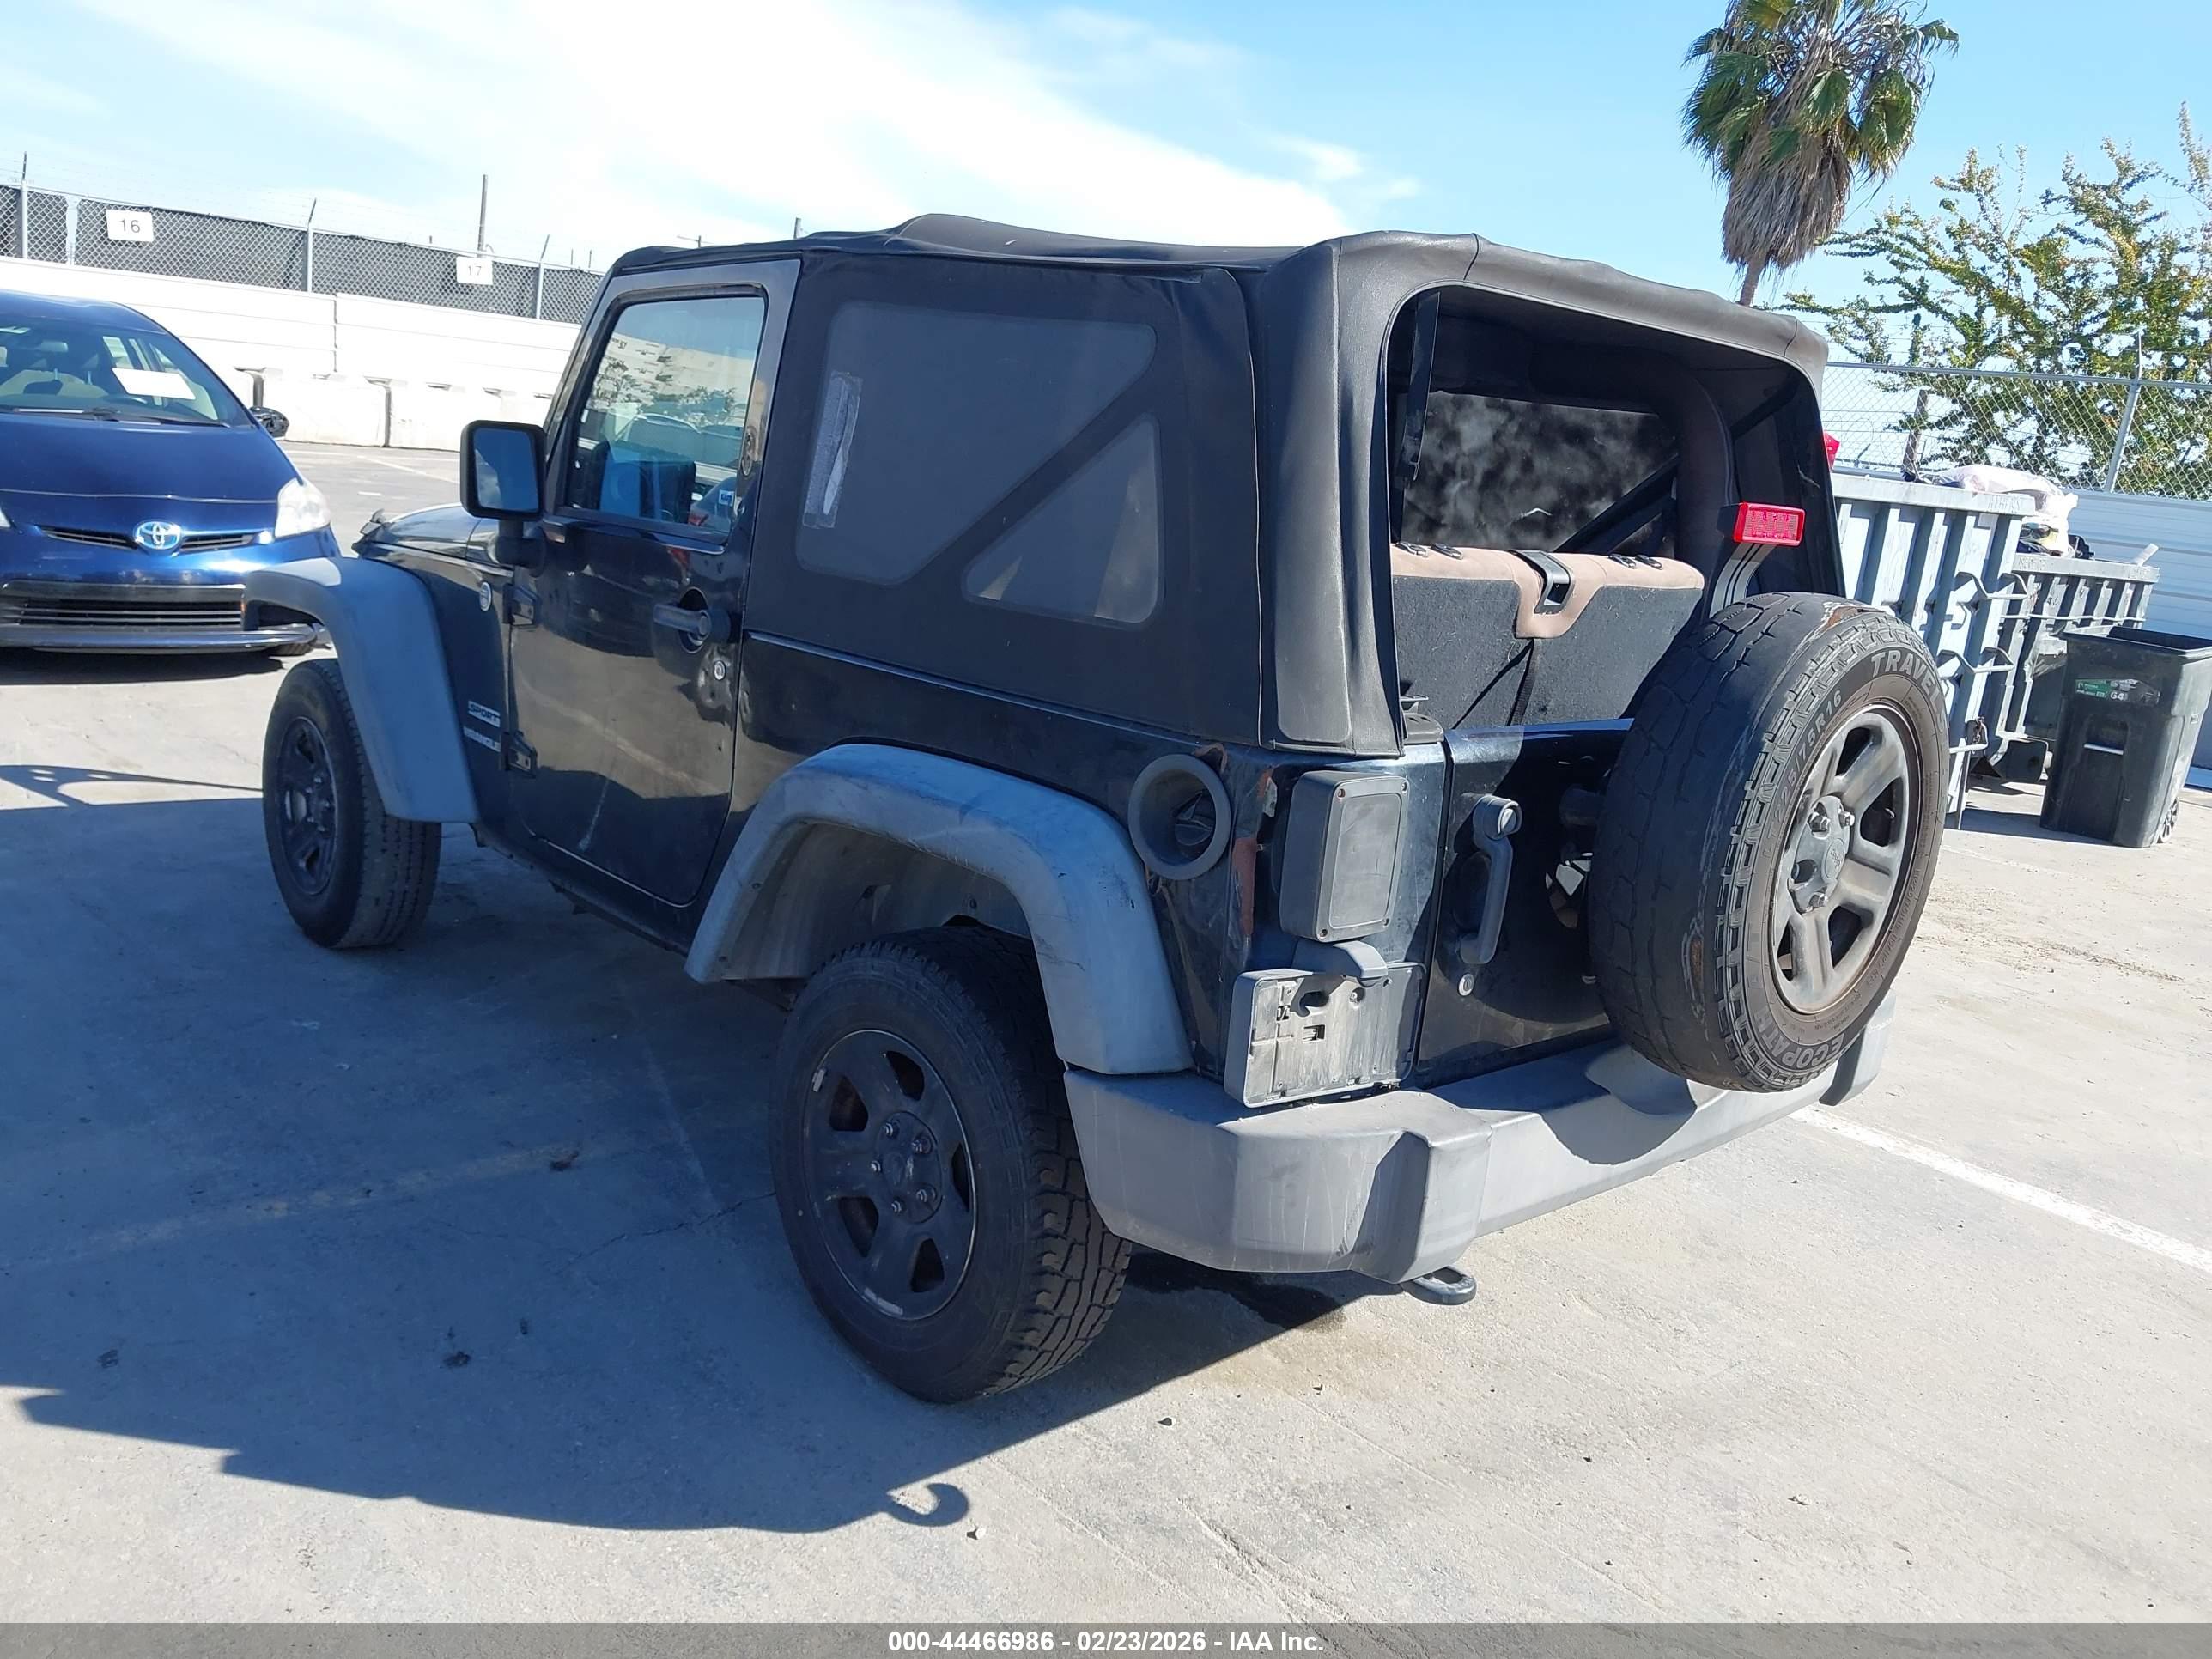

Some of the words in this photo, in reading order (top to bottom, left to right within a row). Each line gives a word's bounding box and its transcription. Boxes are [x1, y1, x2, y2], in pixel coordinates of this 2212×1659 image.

[119, 219, 141, 234] 16
[468, 265, 483, 276] 17
[469, 702, 501, 725] SPORT
[1753, 1006, 1845, 1069] ECOPATH
